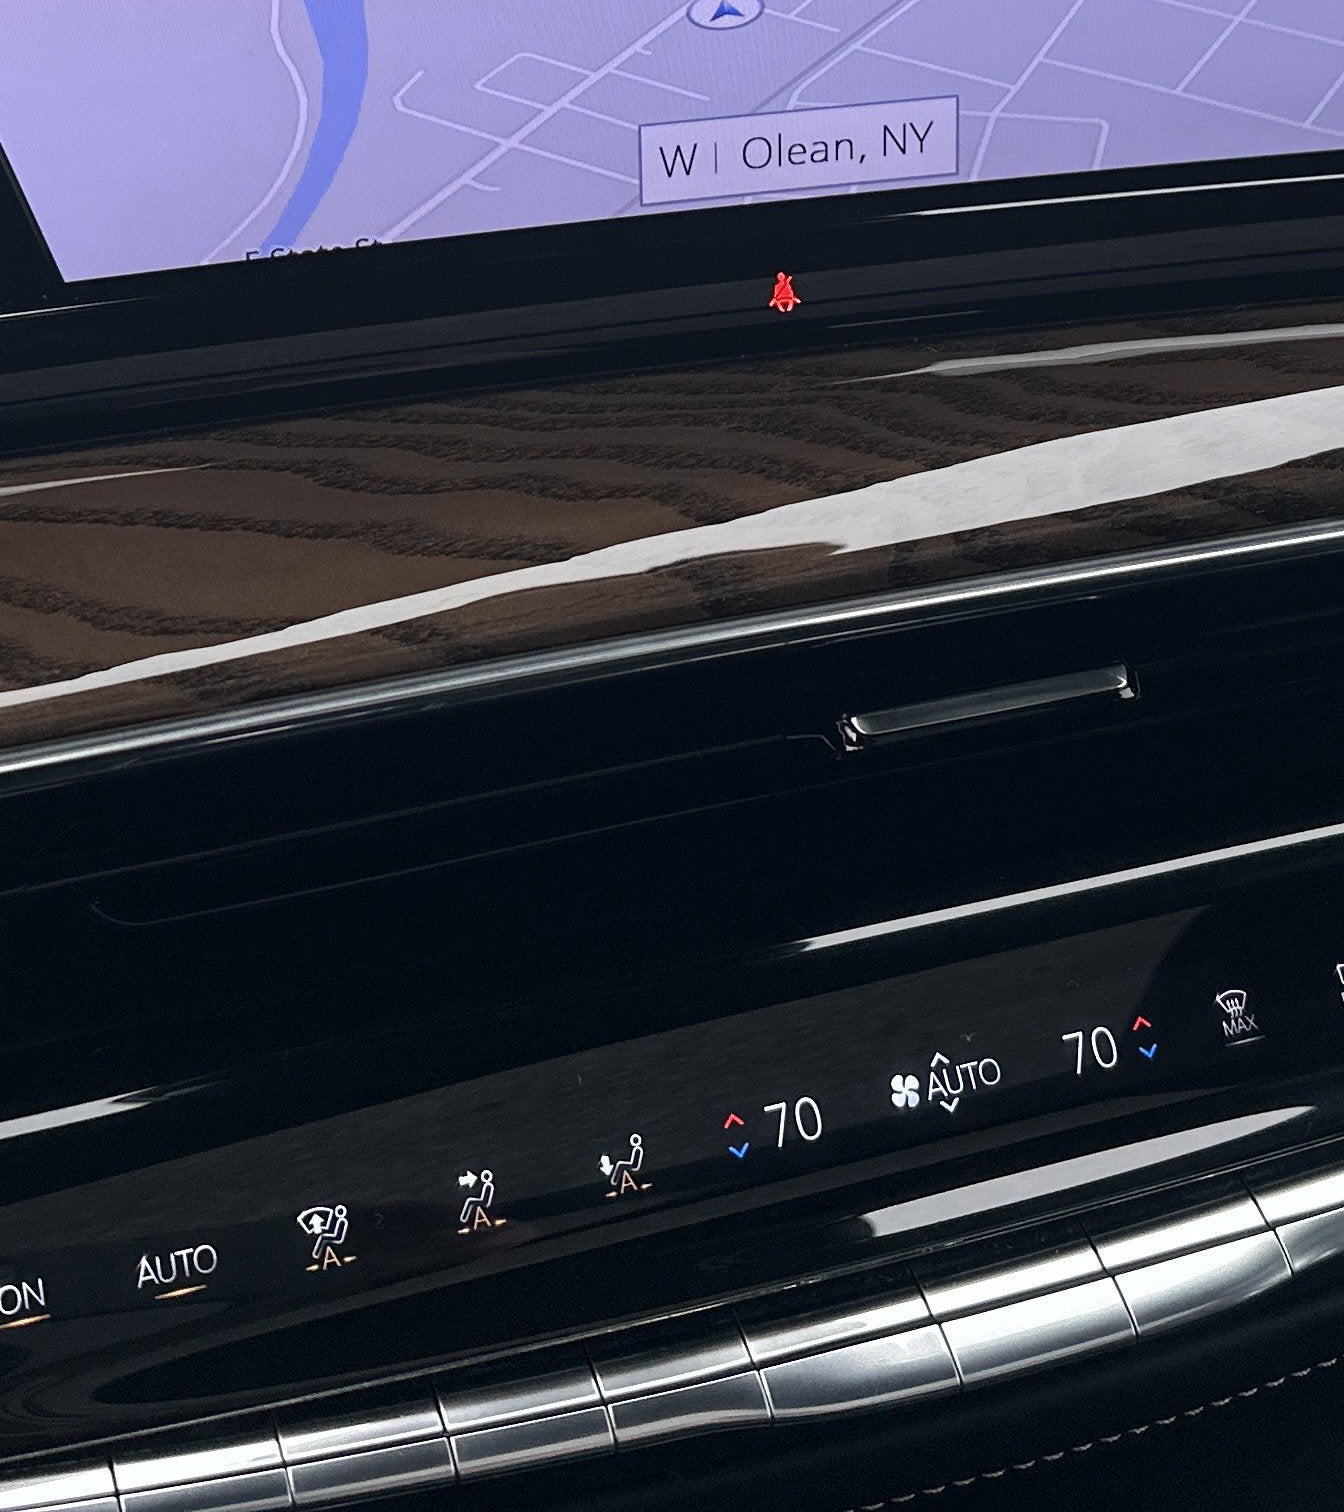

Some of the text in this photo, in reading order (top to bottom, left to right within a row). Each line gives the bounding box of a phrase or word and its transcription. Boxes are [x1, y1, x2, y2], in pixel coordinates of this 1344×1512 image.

[659, 121, 936, 178] W Olean, NY
[1222, 1013, 1259, 1038] MAX
[1061, 1025, 1119, 1075] 70
[925, 1056, 1002, 1101] AUTO
[763, 1096, 823, 1148] 70
[137, 1243, 218, 1288] AUTO
